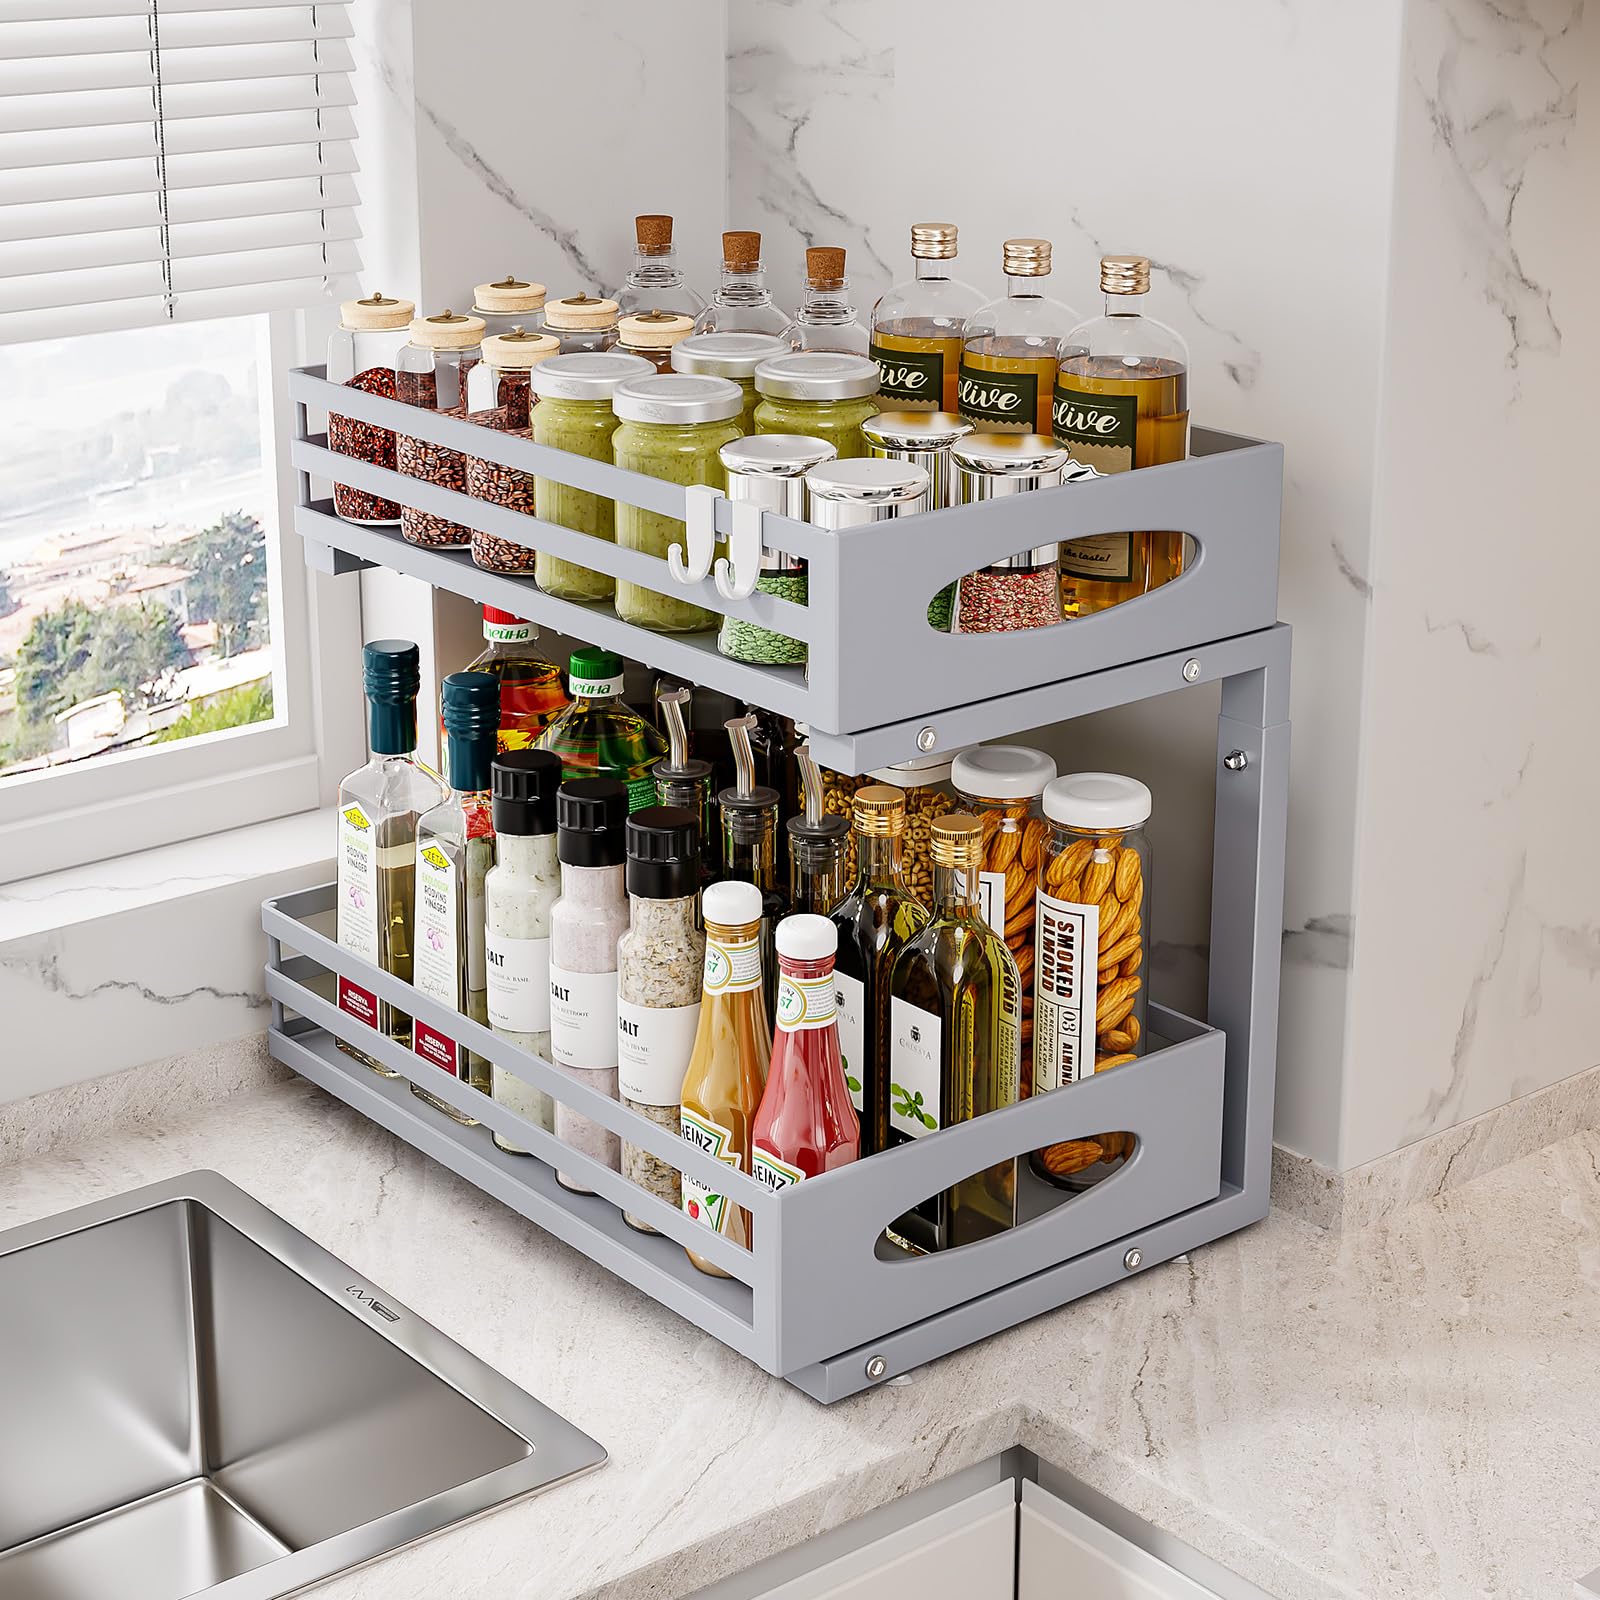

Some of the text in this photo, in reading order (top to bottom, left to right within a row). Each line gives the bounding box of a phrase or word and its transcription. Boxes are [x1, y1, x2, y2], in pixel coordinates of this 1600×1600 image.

[349, 811, 365, 826] ZETA
[427, 850, 445, 866] ZETA
[1042, 913, 1056, 994] ALMOND
[1056, 920, 1075, 999] SMOKED
[707, 960, 719, 974] 57
[780, 995, 793, 1009] 57
[619, 1016, 639, 1037] SALT
[1061, 1010, 1077, 1032] 03
[681, 1124, 713, 1153] HEINZ
[753, 1164, 787, 1191] HEINZ
